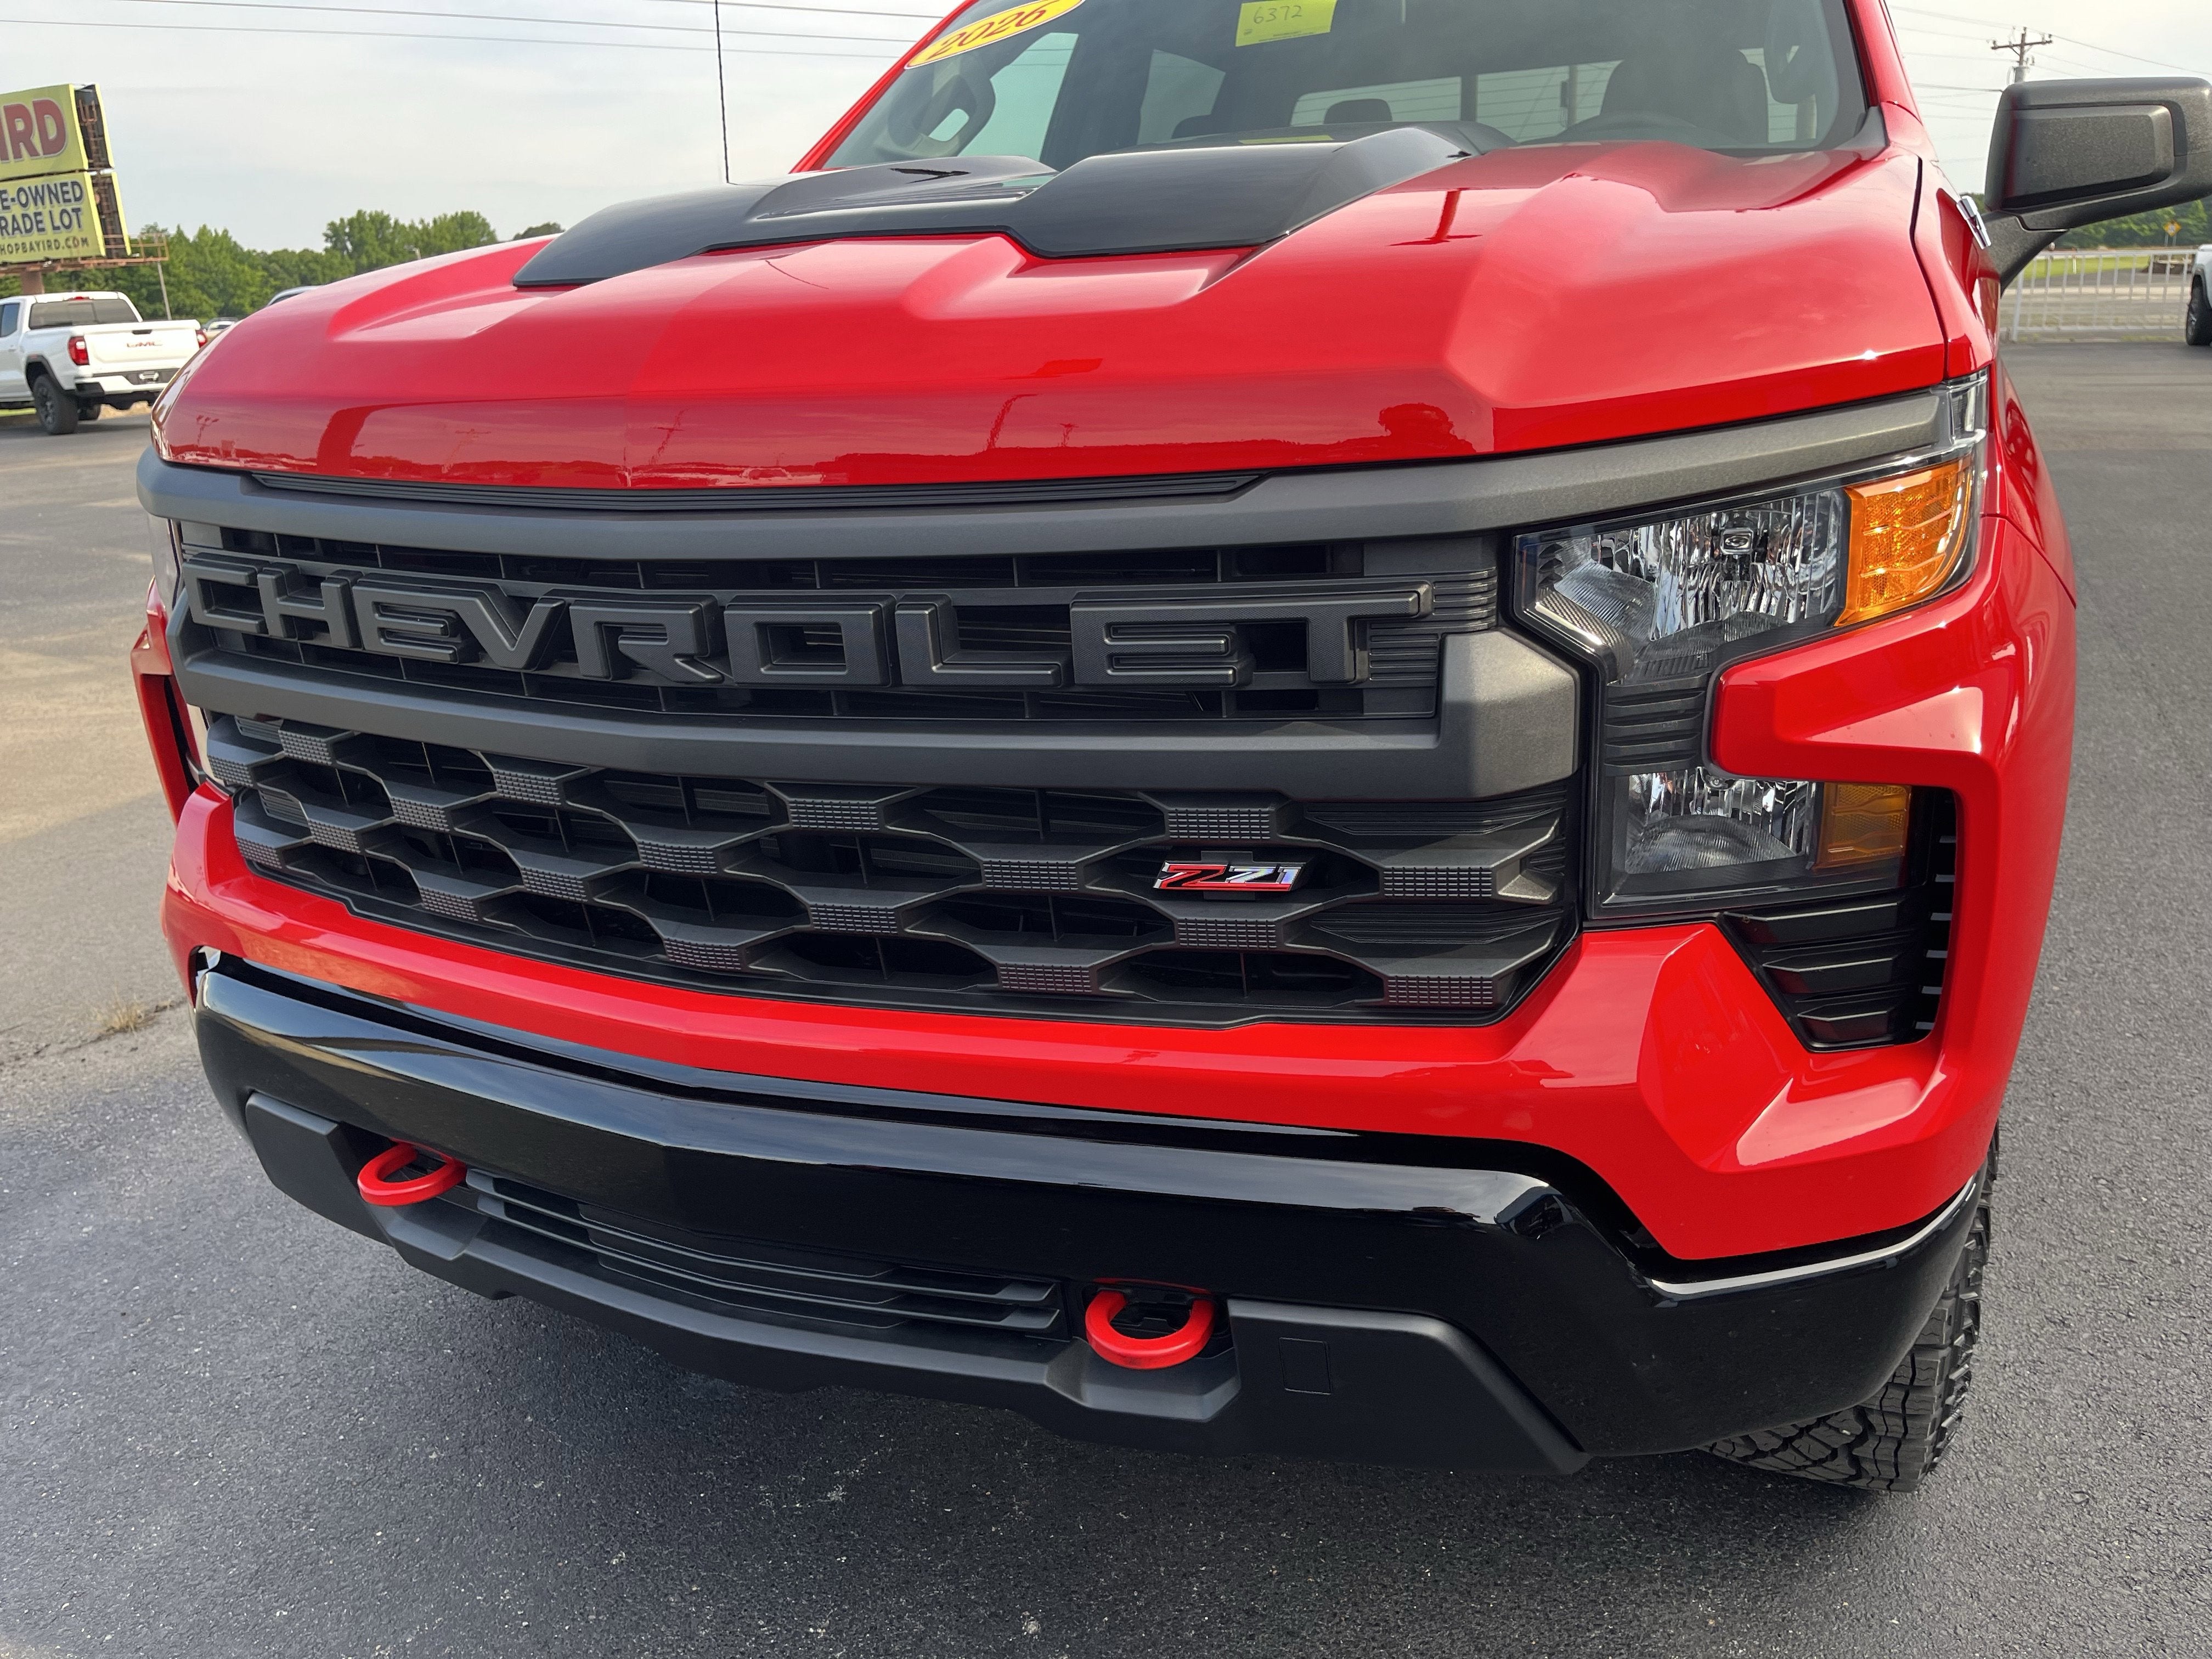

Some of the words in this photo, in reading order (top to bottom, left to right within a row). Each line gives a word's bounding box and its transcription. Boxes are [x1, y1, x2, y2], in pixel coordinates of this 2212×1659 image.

[1253, 5, 1302, 24] 6372
[926, 0, 1060, 60] 2026
[49, 207, 81, 230] LOT
[182, 551, 1432, 688] CHEVROLET
[1153, 861, 1302, 891] Z71
